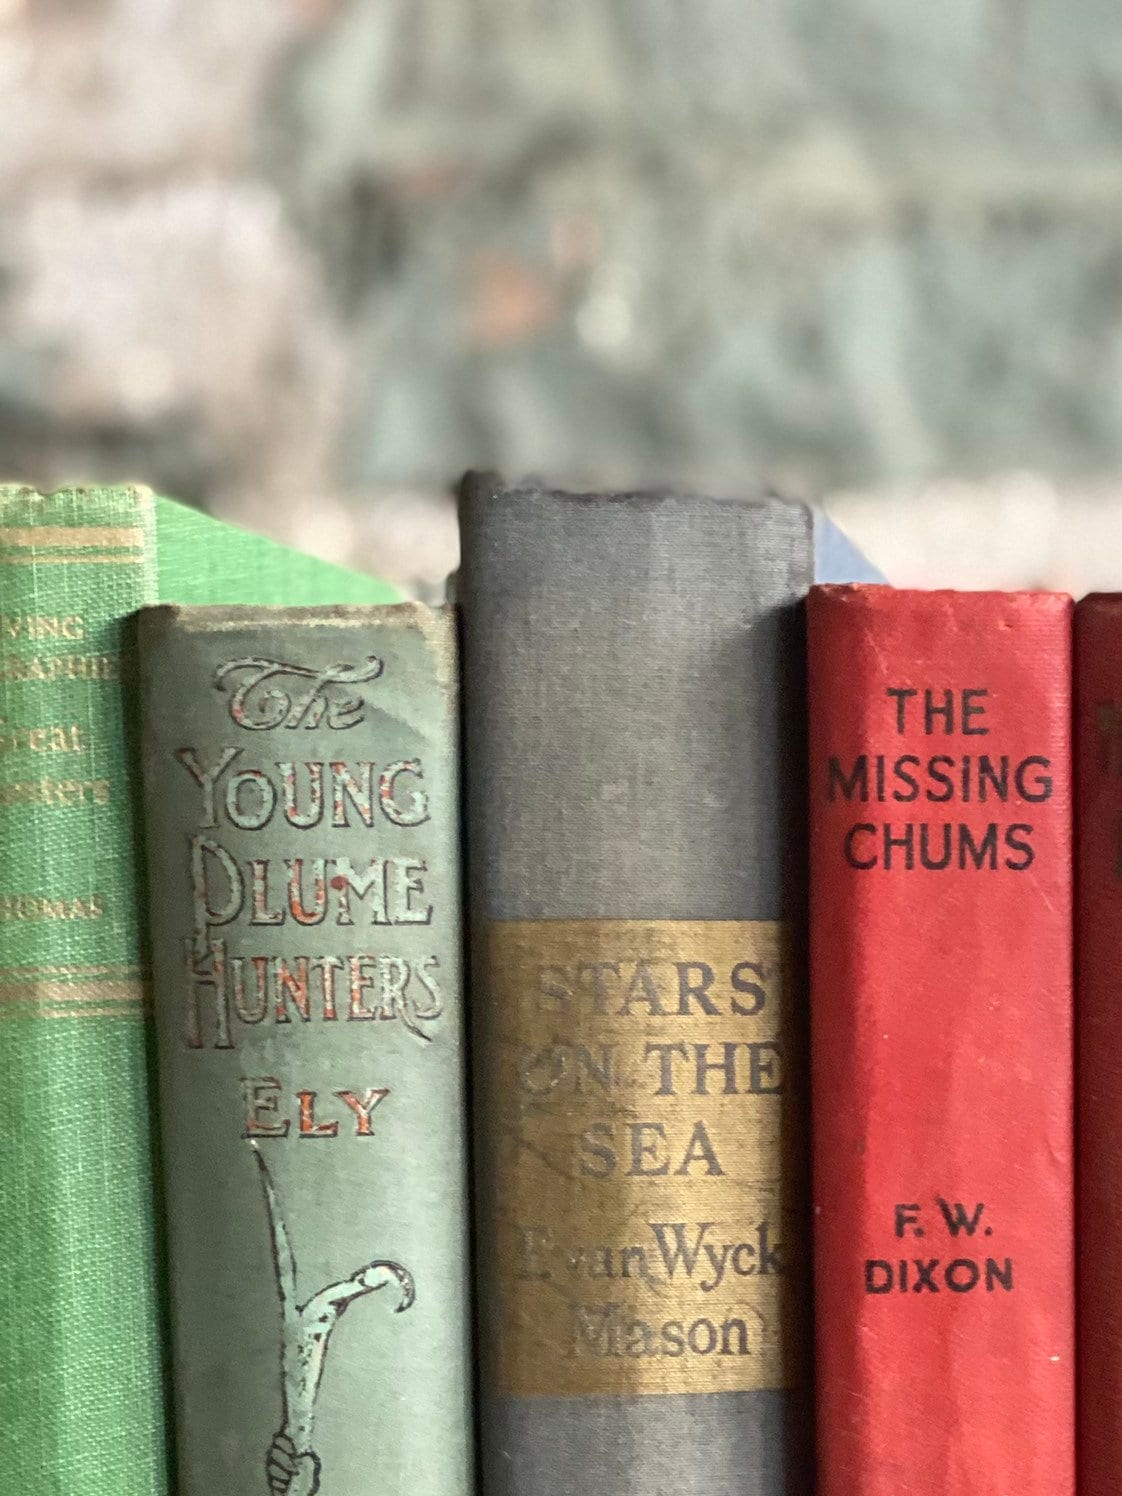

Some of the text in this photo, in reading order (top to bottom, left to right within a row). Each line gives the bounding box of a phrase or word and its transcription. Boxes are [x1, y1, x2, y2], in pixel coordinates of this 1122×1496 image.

[214, 654, 385, 731] The
[886, 686, 990, 738] THE
[175, 745, 431, 830] YOUNG
[827, 754, 1054, 804] MISSING
[843, 822, 1036, 872] CHUMS
[187, 832, 437, 932] PLUME
[181, 933, 445, 1051] HUNTERS
[538, 959, 768, 1018] STARS
[516, 1039, 784, 1098] ON THE
[240, 1073, 393, 1141] ELY
[579, 1119, 727, 1178] SEA
[893, 1197, 994, 1239] F. W.
[864, 1257, 1015, 1295] DIXON
[572, 1302, 752, 1358] Mason
